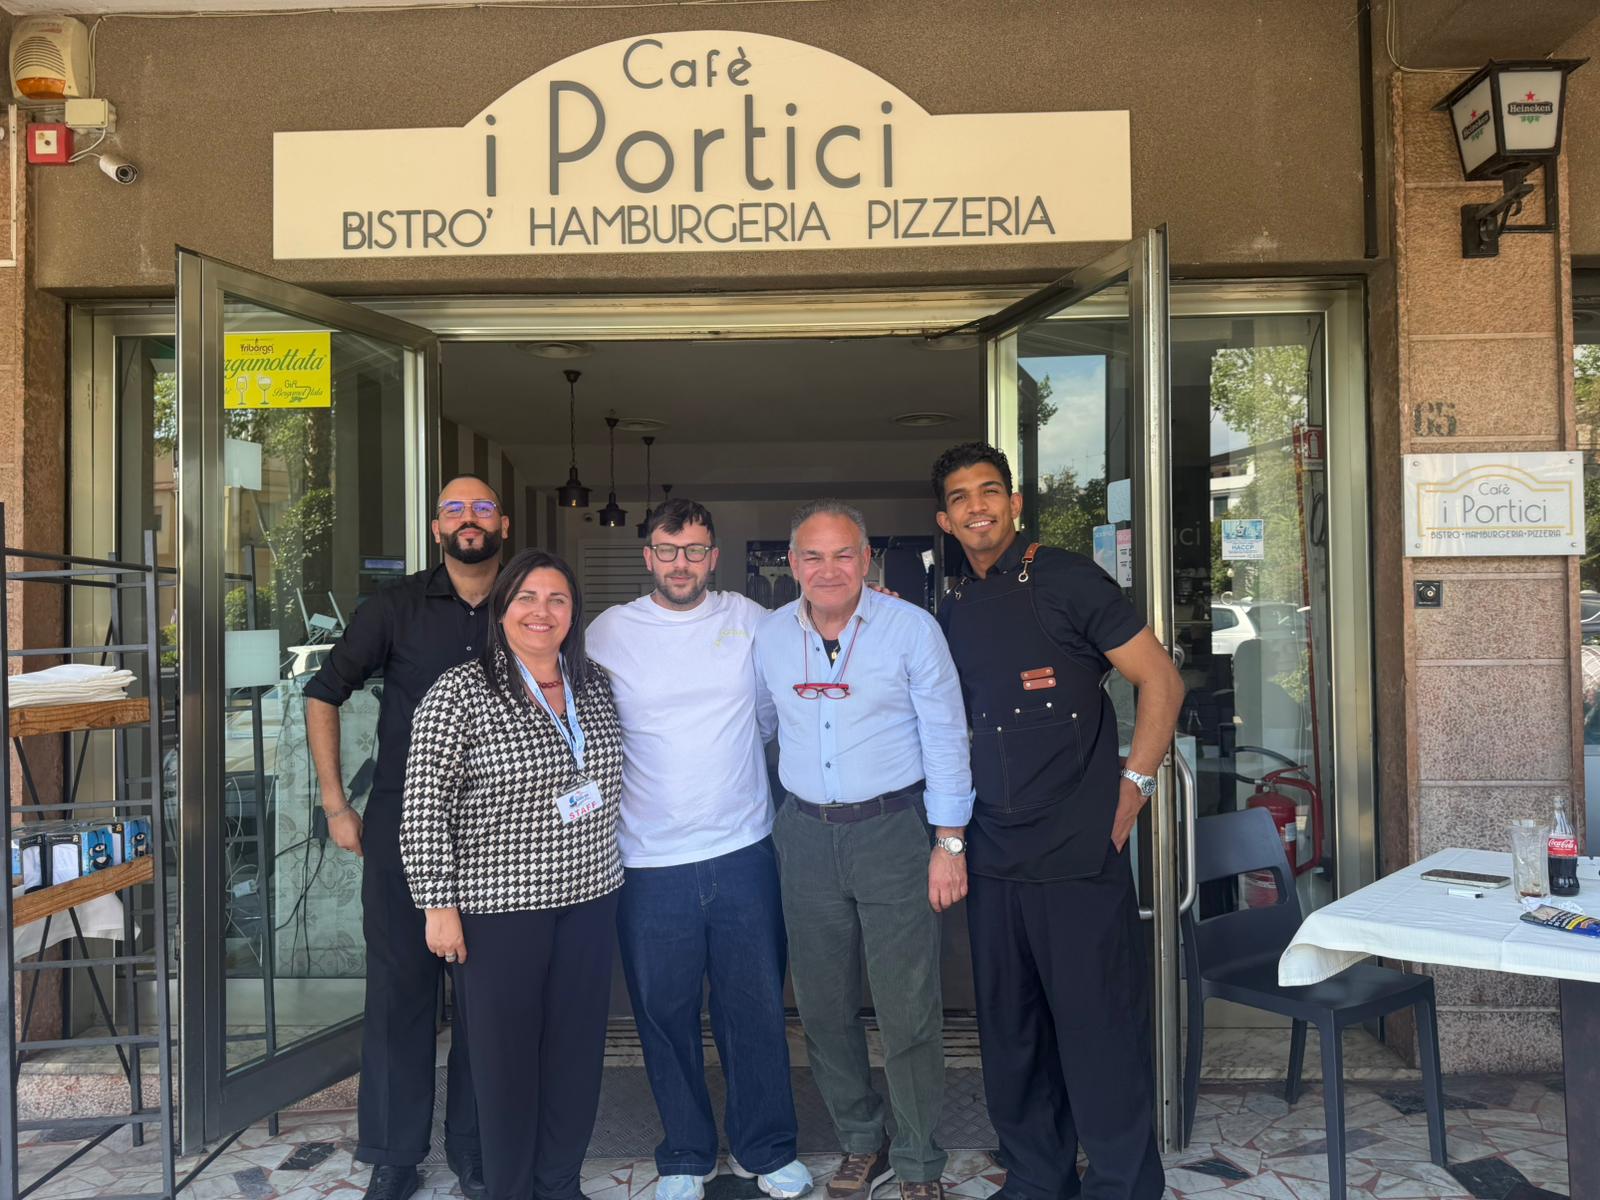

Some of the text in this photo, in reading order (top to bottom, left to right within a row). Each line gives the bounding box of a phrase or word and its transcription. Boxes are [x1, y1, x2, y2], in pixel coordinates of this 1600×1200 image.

[622, 38, 752, 89] Cafè
[1508, 103, 1552, 113] Heineken
[486, 80, 894, 197] i Portici
[530, 200, 831, 246] HAMBURGERIA
[868, 195, 1056, 240] PIZZERIA
[1478, 482, 1511, 496] Cafè
[1443, 495, 1547, 524] i Portici
[569, 801, 597, 820] STAFF
